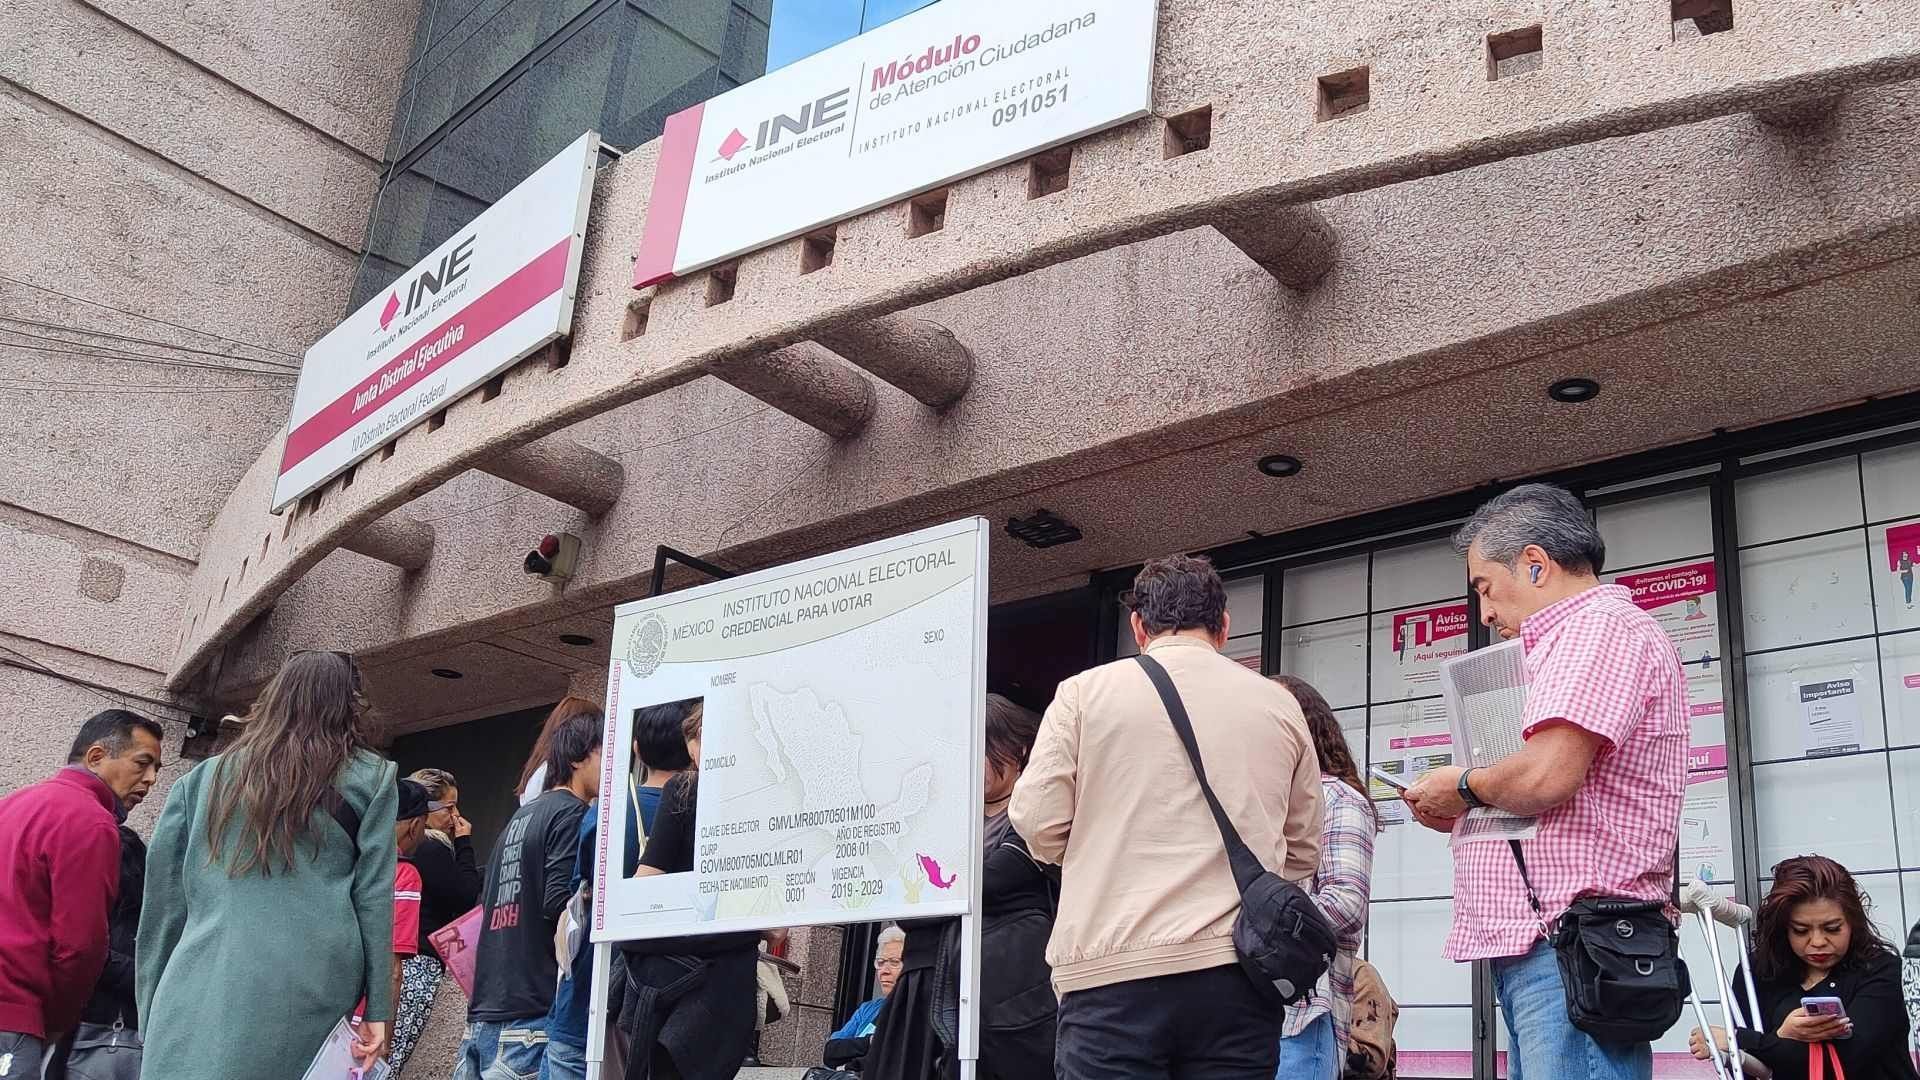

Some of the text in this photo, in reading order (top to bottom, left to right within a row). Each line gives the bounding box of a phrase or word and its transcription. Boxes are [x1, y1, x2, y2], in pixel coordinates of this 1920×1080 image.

[869, 12, 1097, 110] de Atención Ciudadana
[871, 34, 981, 92] Módulo
[859, 66, 1070, 153] INSTITUTO NACIONAL ELECTORAL
[992, 84, 1069, 127] 091051
[756, 87, 850, 151] INE
[705, 122, 846, 184] Instituto Nacional Electoral
[404, 233, 477, 318] INE
[366, 278, 467, 361] Instituto Nacional Electoral
[351, 324, 465, 415] Junta Distrital Ejecutiva
[352, 377, 448, 454] 10 Distrito Electoral Federal
[722, 549, 956, 618] INSTITUTO NACIONAL ELECTORAL
[1650, 574, 1707, 593] COVID-19!
[721, 593, 873, 640] CREDENCIAL PARA VOTAR
[1436, 612, 1467, 625] Aviso
[924, 629, 944, 644] SEXO
[1435, 622, 1468, 633] Importan
[1435, 648, 1468, 659] seguimo
[711, 672, 737, 688] NOMBRE
[1827, 681, 1850, 689] Aviso
[1803, 687, 1851, 699] Importante
[705, 754, 736, 771] DOMICILIO
[1688, 752, 1709, 769] quí
[700, 803, 876, 839] CLAVE DE ELECTOR GMVLMR80070501M100
[836, 821, 901, 841] AÑO DE REGISTRO
[700, 843, 718, 857] CURP
[836, 841, 870, 859] 2008 01
[785, 869, 816, 887] SECCIÓN
[832, 866, 865, 881] VIGENCIA
[699, 875, 769, 894] FECHA DE NACIMIENTO
[831, 882, 853, 899] 2019
[861, 880, 883, 897] 2029
[785, 887, 805, 903] 0001
